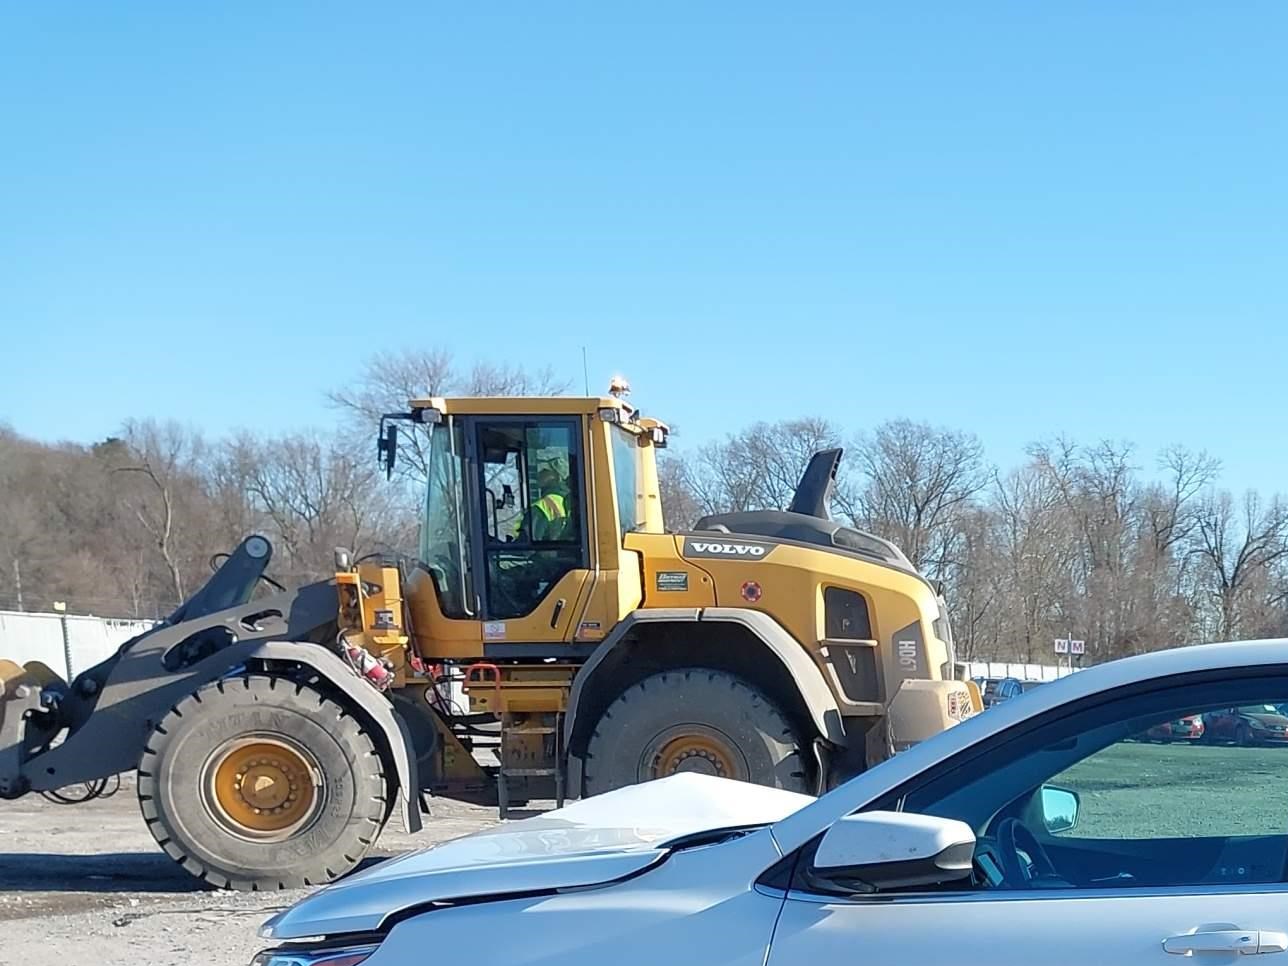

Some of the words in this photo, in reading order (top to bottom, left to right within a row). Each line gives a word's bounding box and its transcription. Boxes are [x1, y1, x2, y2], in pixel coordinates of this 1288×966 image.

[690, 542, 765, 556] VOLVO
[1057, 641, 1067, 651] N
[1072, 642, 1083, 652] M
